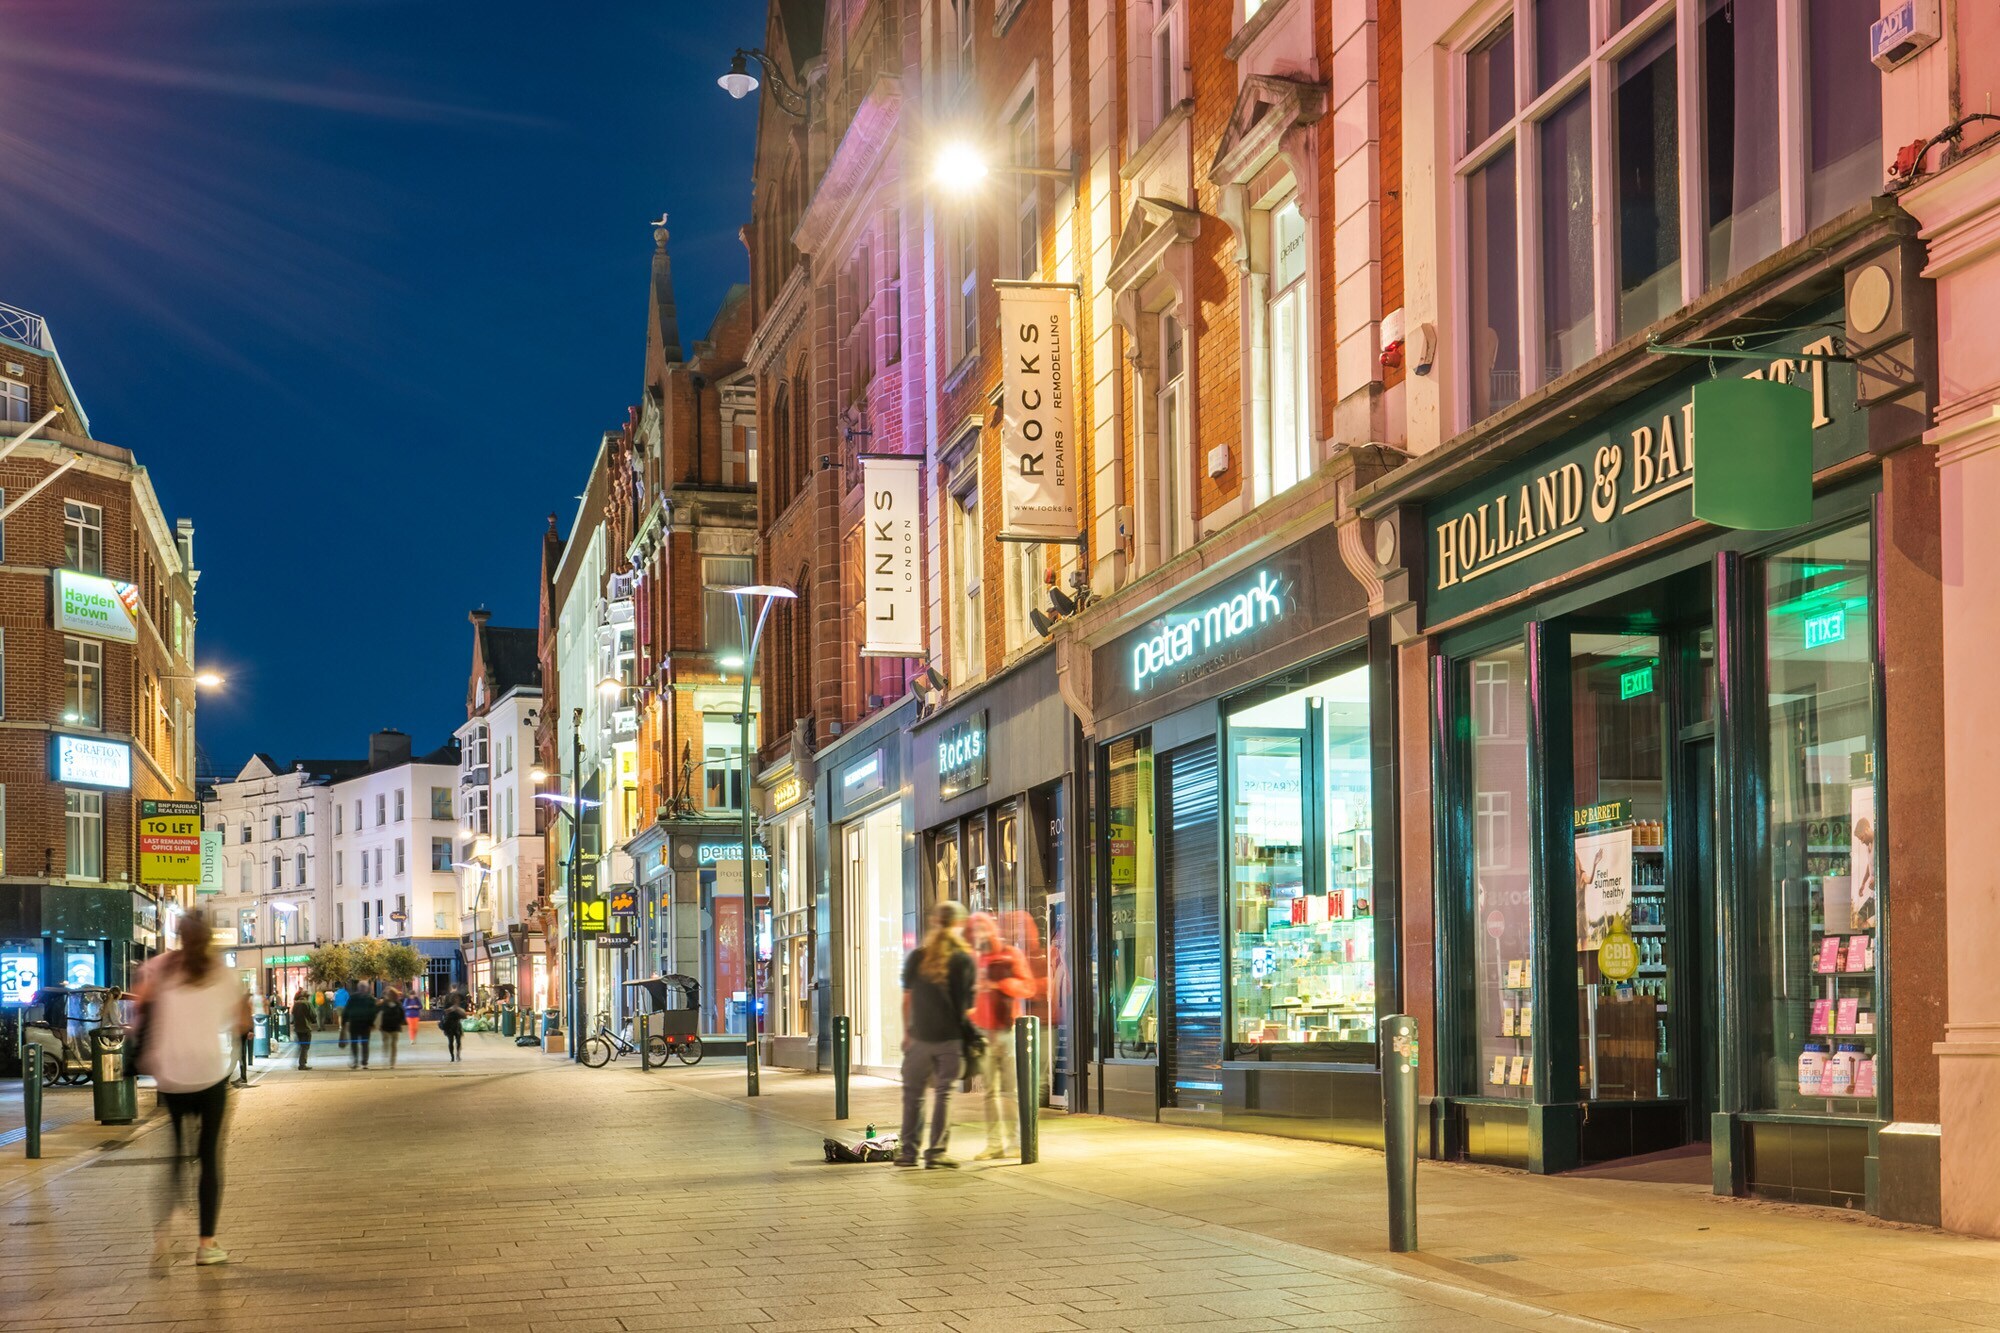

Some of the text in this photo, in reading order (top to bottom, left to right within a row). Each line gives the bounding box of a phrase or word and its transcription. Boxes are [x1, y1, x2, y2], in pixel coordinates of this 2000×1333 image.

[1880, 9, 1905, 43] ADT
[1050, 314, 1062, 409] REMODELLING
[1020, 323, 1045, 477] ROCKS
[1056, 430, 1065, 487] REPAIRS
[1014, 504, 1073, 513] www.rocks.ie
[1437, 462, 1584, 591] HOLLAND
[1591, 444, 1622, 523] &
[874, 490, 894, 621] LINKS
[904, 520, 912, 592] LONDON
[65, 587, 115, 608] Hayden
[65, 601, 108, 621] Brown
[95, 620, 132, 633] Accountants
[1134, 570, 1281, 691] peter mark
[1624, 670, 1649, 695] EXIT
[75, 743, 121, 757] GRAFTON
[939, 730, 981, 773] ROCKS
[1581, 809, 1588, 825] &
[1588, 802, 1621, 822] BARRETT
[148, 822, 193, 834] TO LET
[156, 855, 173, 863] 111
[201, 838, 217, 883] Dubray
[1594, 875, 1622, 889] summer
[1596, 869, 1609, 879] Feel
[1602, 886, 1625, 900] healthy
[598, 936, 629, 944] Dune
[1604, 943, 1631, 960] CBD
